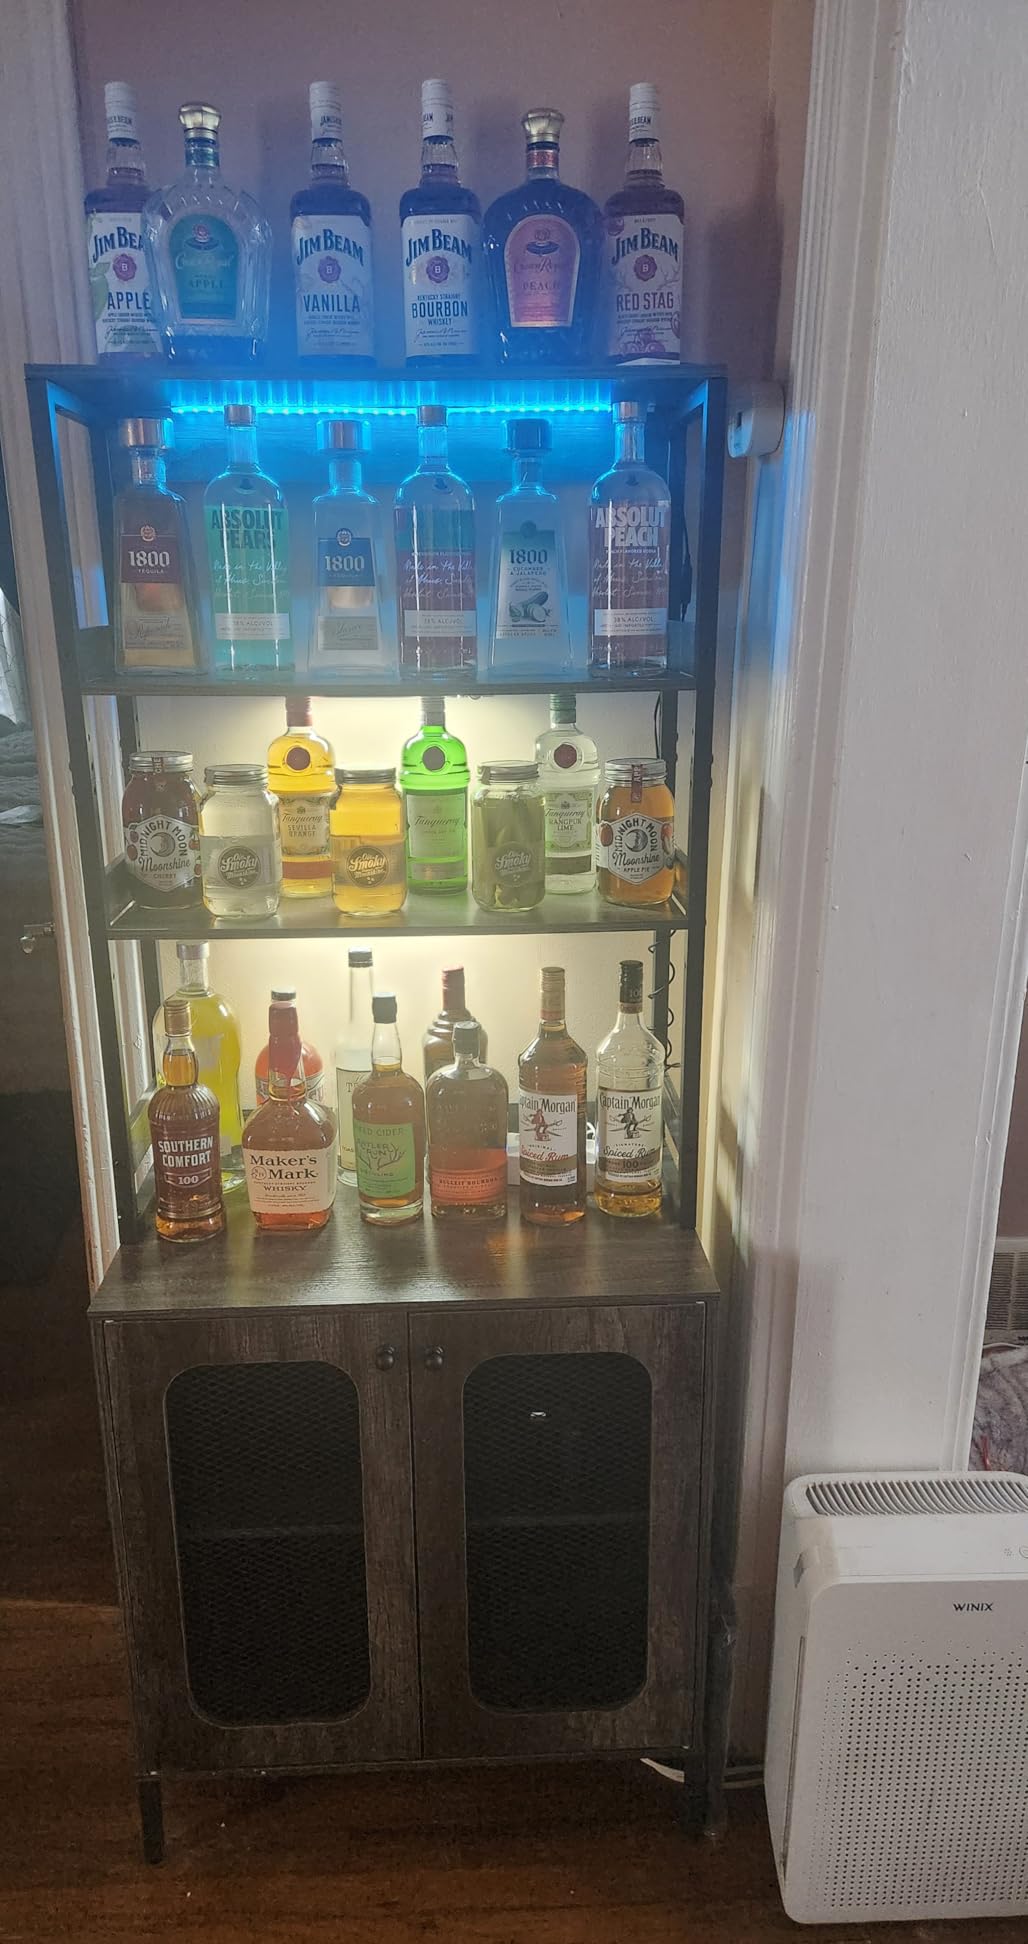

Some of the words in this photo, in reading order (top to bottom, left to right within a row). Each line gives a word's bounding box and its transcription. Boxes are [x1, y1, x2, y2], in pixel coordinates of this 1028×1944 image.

[92, 233, 115, 262] JIM
[296, 234, 322, 266] JIM
[323, 228, 364, 266] BEAM
[406, 235, 430, 267] JIM
[432, 228, 472, 264] BEAM
[611, 236, 638, 266] JIM
[640, 227, 678, 262] BEAM
[107, 292, 152, 310] APPLE
[303, 294, 360, 313] VANILLA
[412, 300, 468, 318] BOURBON
[616, 293, 640, 311] RED
[643, 292, 674, 309] STAG
[428, 318, 452, 326] WHISKEY
[212, 509, 282, 530] ABSOLUT
[596, 506, 664, 528] ABSOLUT
[220, 530, 276, 550] PEARS
[604, 526, 658, 547] PEACH
[128, 550, 170, 568] 1800
[324, 556, 365, 572] 1800
[510, 548, 548, 564] 1800
[140, 820, 172, 856] MIDNIGHT
[172, 825, 188, 857] MOON
[614, 818, 645, 852] MIDNIGHT
[645, 822, 658, 852] MOON
[138, 856, 191, 873] Moonshine
[220, 855, 258, 872] Smoky
[348, 854, 386, 872] Smoky
[495, 852, 531, 870] Smoky
[612, 852, 660, 867] Moonshine
[541, 1098, 576, 1114] Morgan
[600, 1092, 630, 1110] Captain
[158, 1136, 214, 1153] SOUTHERN
[604, 1146, 634, 1158] Spiced
[162, 1150, 211, 1168] COMFORT
[250, 1154, 317, 1166] Maker's
[545, 1151, 569, 1162] Rum
[622, 1160, 639, 1169] 100
[178, 1176, 199, 1185] 100
[268, 1168, 317, 1180] Mark
[953, 1602, 993, 1611] WINIX
